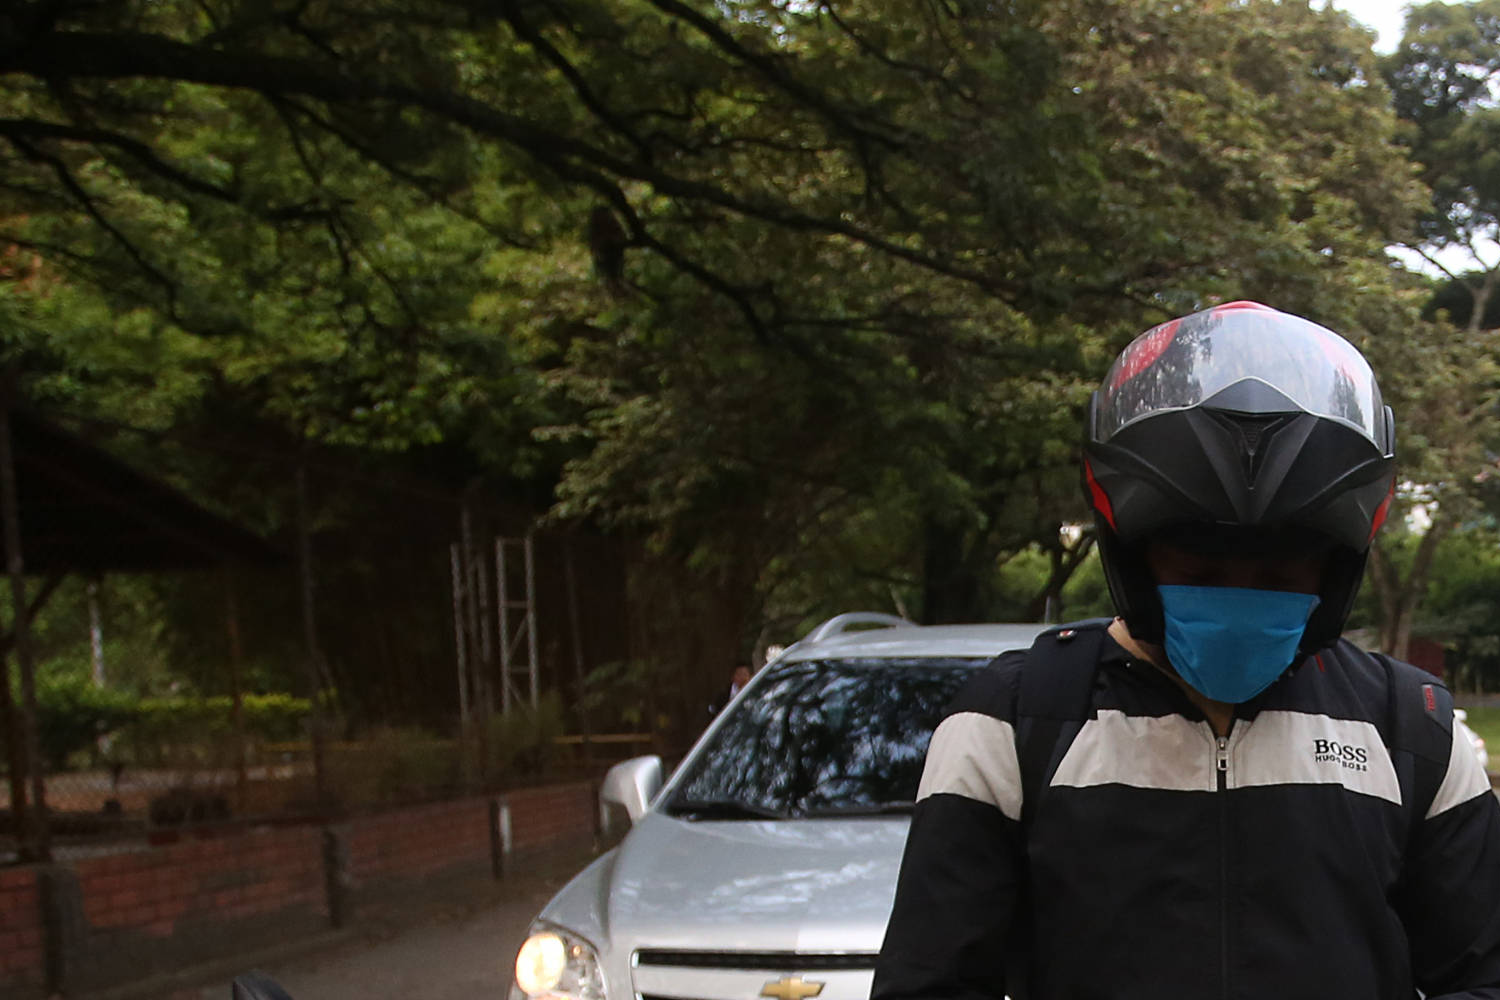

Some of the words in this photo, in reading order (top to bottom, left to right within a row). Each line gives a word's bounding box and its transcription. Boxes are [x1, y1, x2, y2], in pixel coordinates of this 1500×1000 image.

[1313, 739, 1367, 763] BOSS
[1315, 755, 1341, 763] HUGO
[1342, 761, 1367, 771] BOSS
